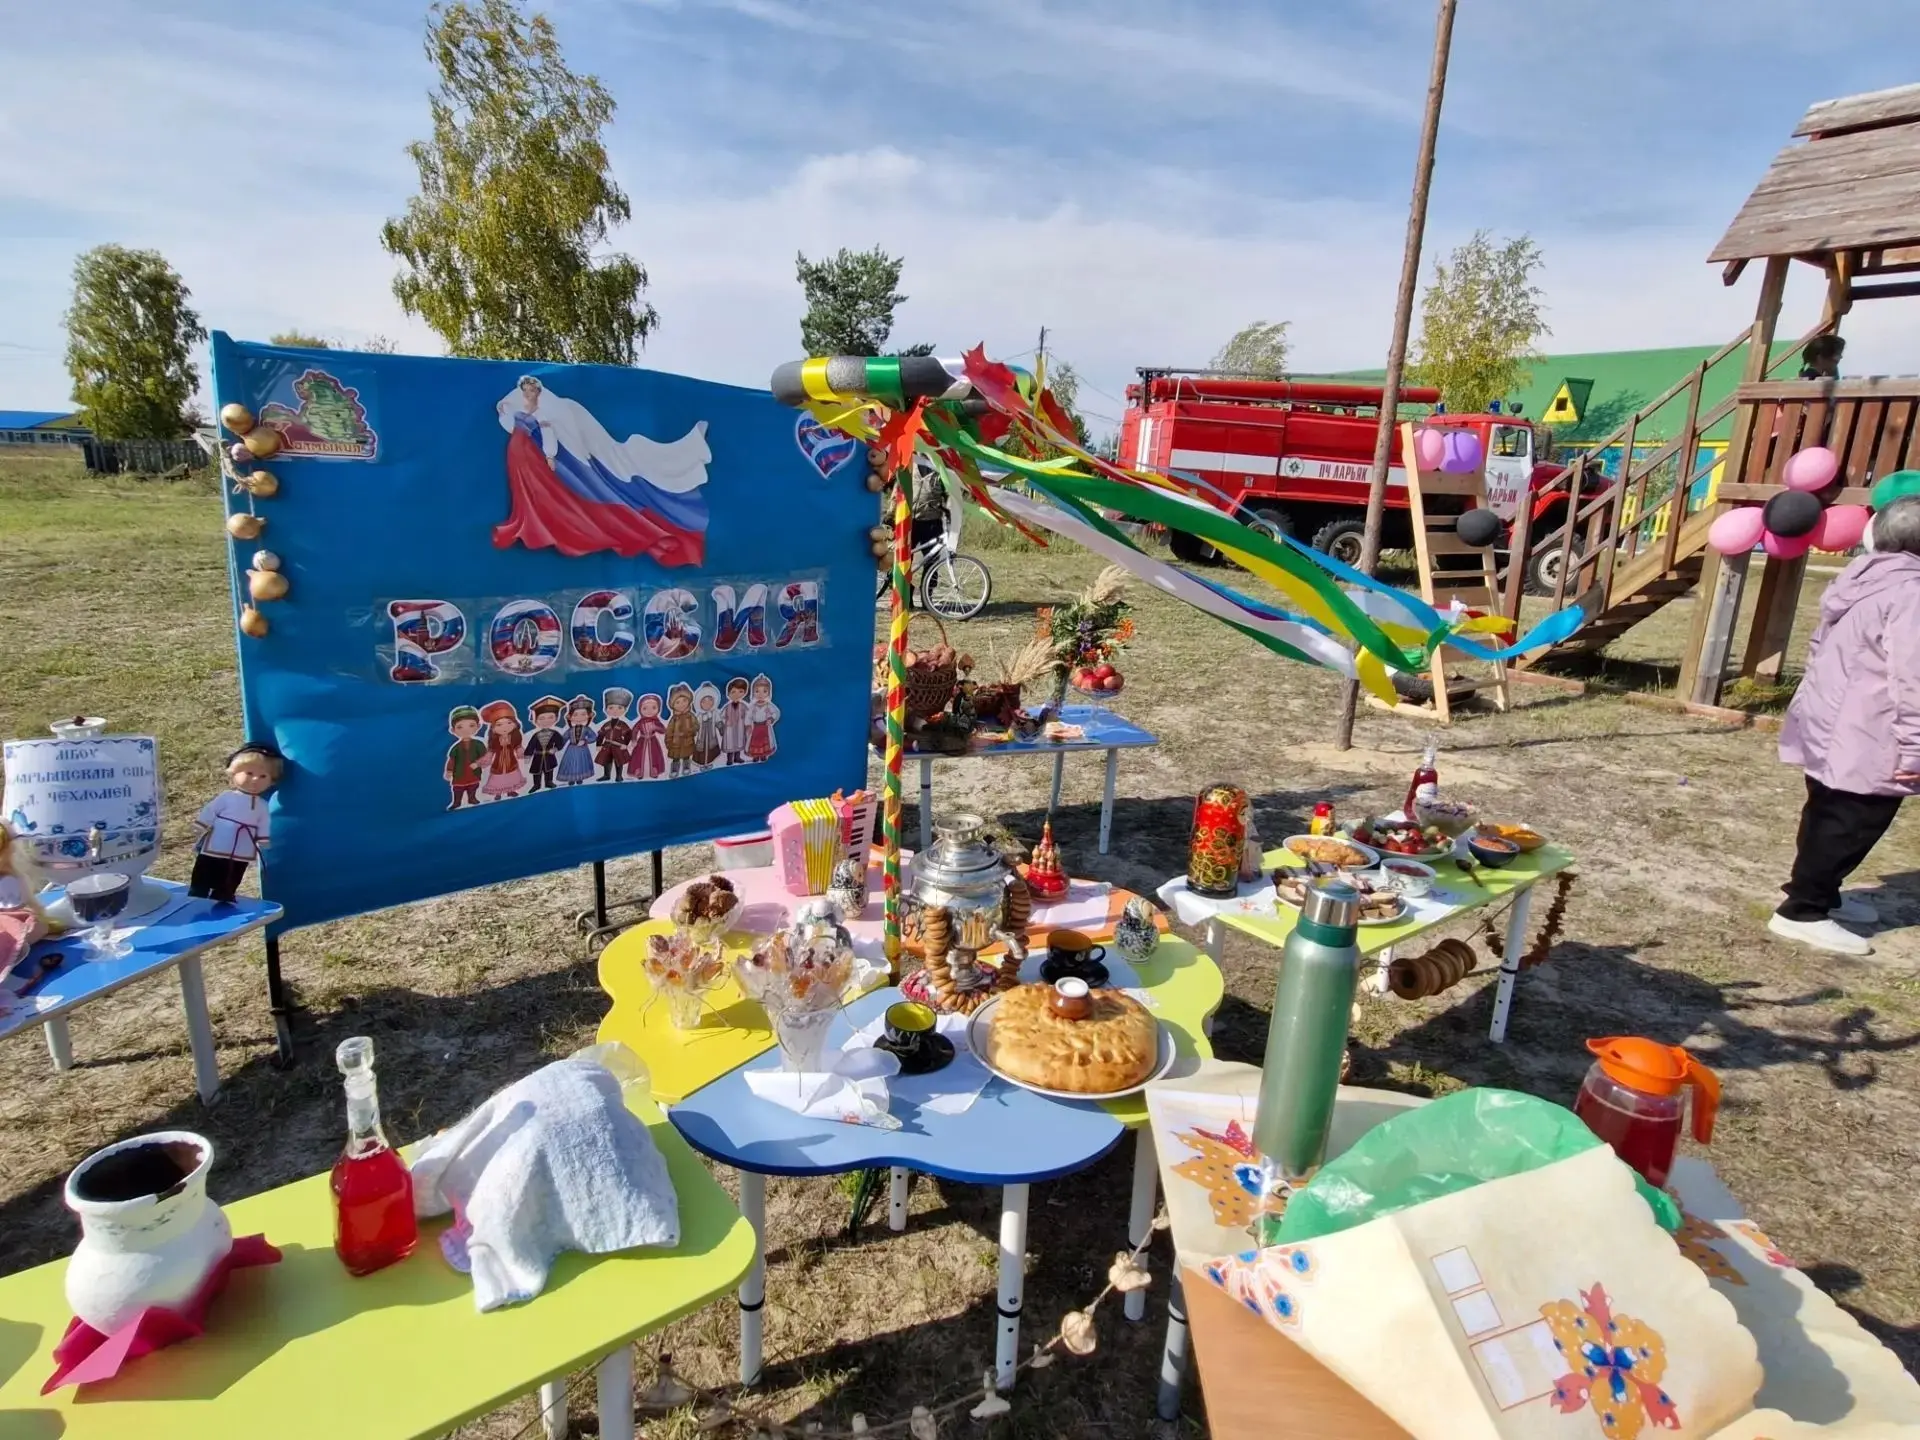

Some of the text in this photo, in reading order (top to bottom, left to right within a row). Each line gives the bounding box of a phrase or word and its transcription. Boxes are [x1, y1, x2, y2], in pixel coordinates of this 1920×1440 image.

[1319, 463, 1368, 482] ПЧ ЛАРЬЯК
[1497, 472, 1508, 486] ПЧ
[387, 581, 819, 682] РОССИЯ
